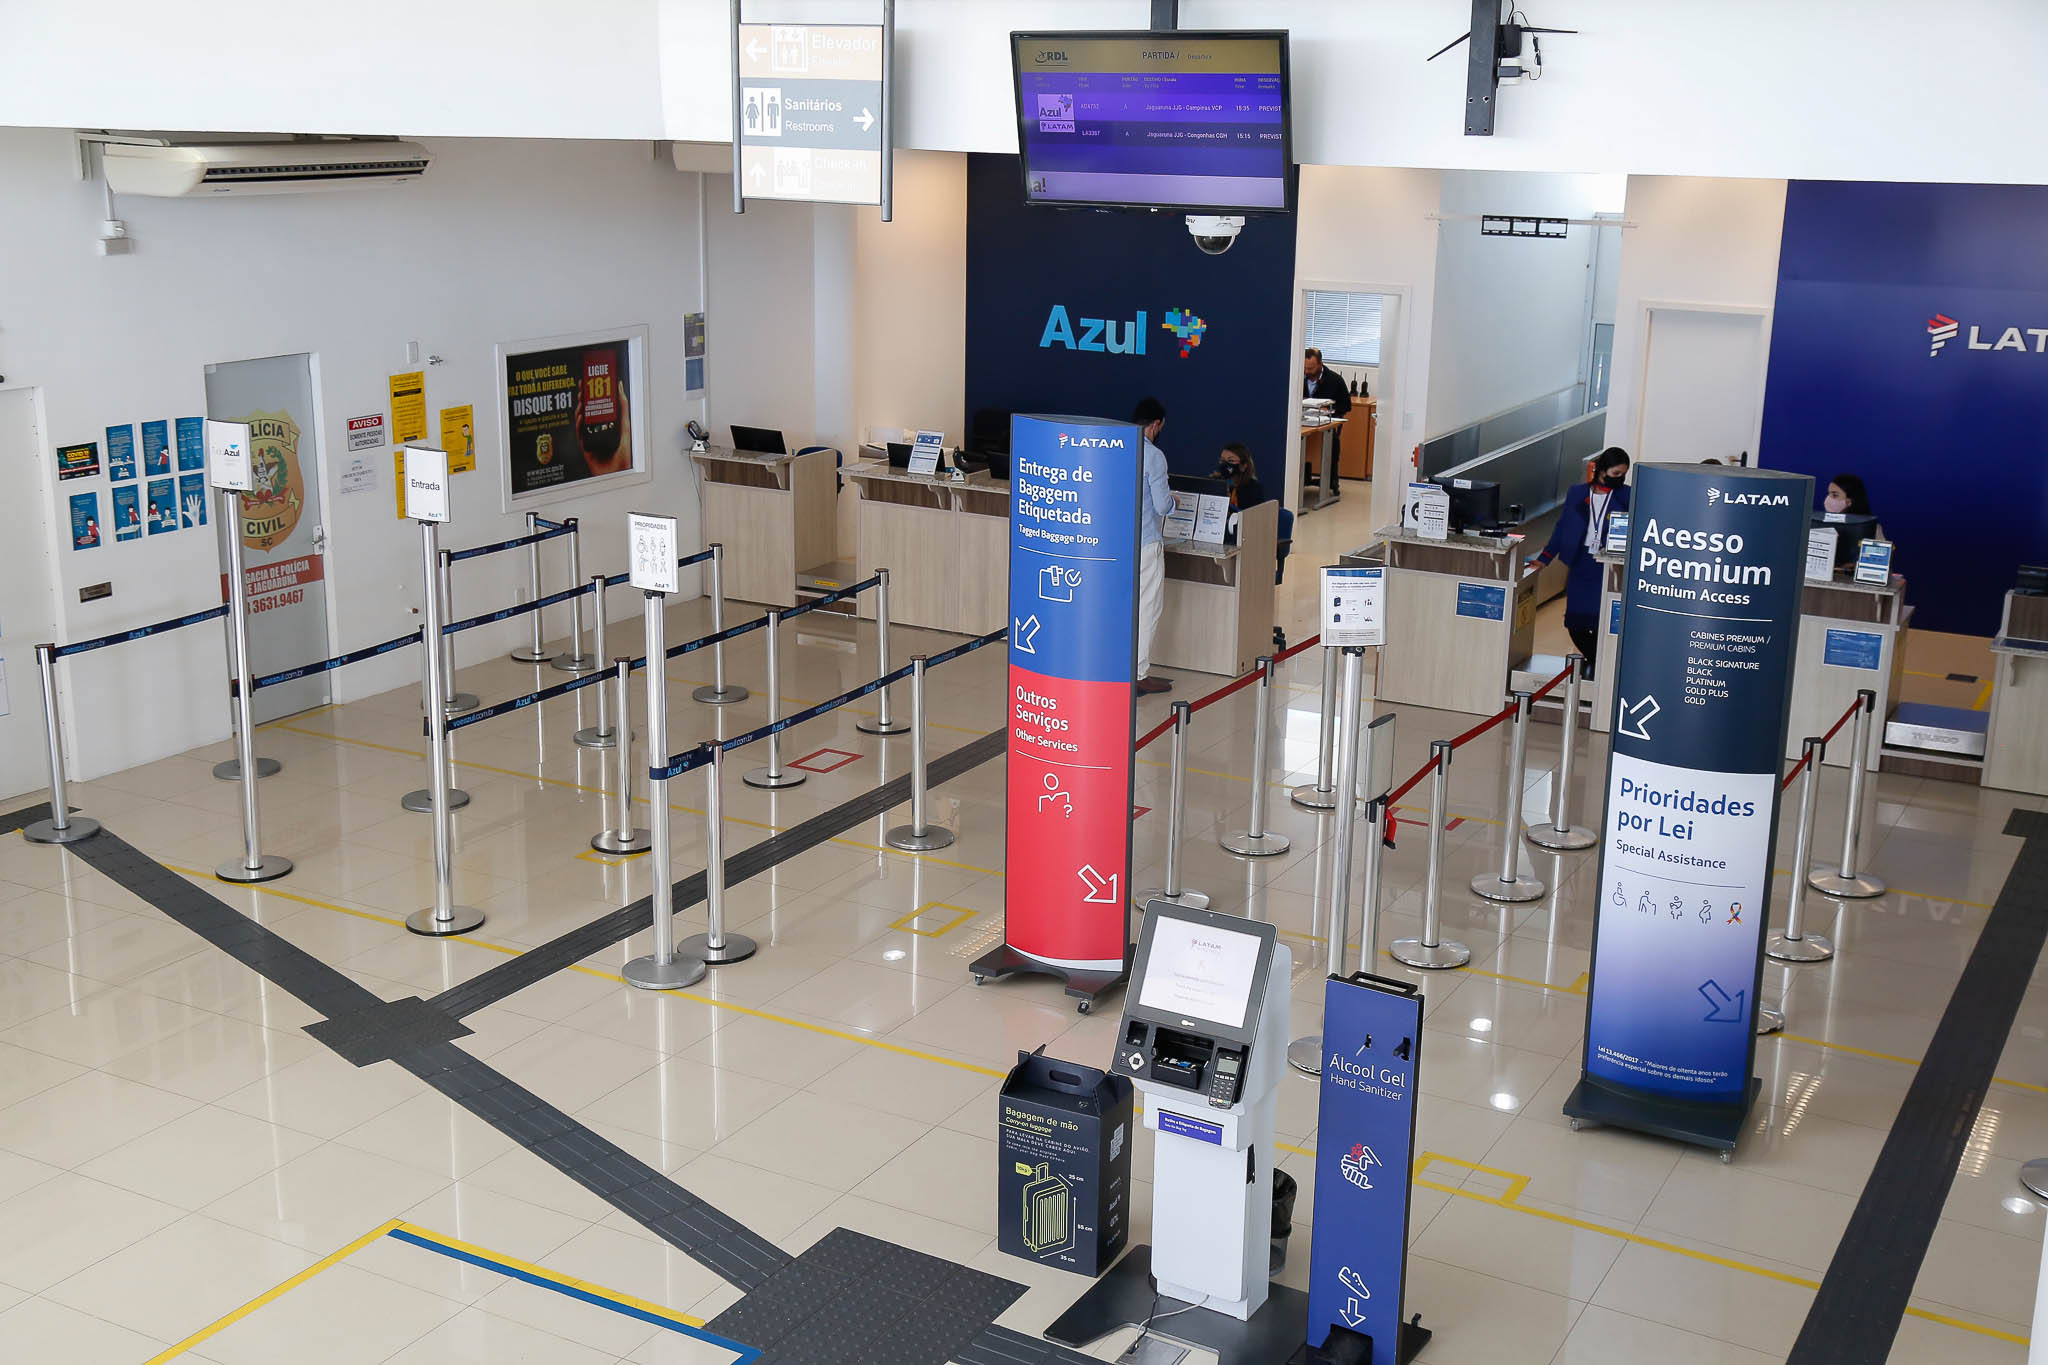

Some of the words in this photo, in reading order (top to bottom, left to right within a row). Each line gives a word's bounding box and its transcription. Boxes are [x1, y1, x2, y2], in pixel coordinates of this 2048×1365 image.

[811, 31, 877, 50] Elevador
[1046, 51, 1068, 61] RDL
[1142, 51, 1174, 60] PARTIDA
[784, 97, 843, 113] Sanitários
[1039, 107, 1062, 118] Azul
[785, 120, 834, 133] Restrooms
[1039, 304, 1147, 355] Azul
[1967, 325, 2048, 353] LAT
[521, 369, 534, 381] QUE
[551, 364, 568, 376] SABE
[588, 364, 609, 377] LIGUE
[520, 383, 536, 395] TODA
[587, 375, 611, 399] 181
[513, 394, 553, 416] DISQUE
[554, 391, 572, 410] 181
[250, 419, 285, 438] LÍCIA
[352, 417, 379, 429] AVISO
[355, 438, 380, 447] AUTORIZADAS
[1070, 437, 1124, 449] LATAM
[1019, 457, 1067, 484] Entrega
[1072, 465, 1093, 483] de
[411, 478, 441, 491] Entrada
[1018, 478, 1078, 504] Bagagem
[1724, 492, 1790, 506] LATAM
[1018, 499, 1092, 525] Etiquetada
[246, 517, 286, 535] CIVIL
[634, 521, 668, 530] PRIORIDADES
[260, 537, 273, 546] SC
[1018, 524, 1040, 538] Tagged
[1041, 529, 1075, 544] Baggage
[1076, 534, 1099, 546] Drop
[1642, 518, 1744, 554] Acesso
[269, 566, 280, 578] DE
[280, 560, 310, 576] POLÍCIA
[1639, 547, 1772, 586] Premium
[254, 574, 297, 594] JAGUARUNA
[1637, 578, 1696, 600] Premium
[1700, 588, 1750, 605] Access
[253, 588, 304, 614] 3631.9467
[128, 628, 145, 640] Azul
[1690, 630, 1725, 642] CABINES
[1726, 634, 1765, 644] PREMIUM
[685, 641, 699, 651] Azul
[1689, 641, 1726, 652] PREMIUM
[1727, 644, 1756, 653] CABINS
[325, 657, 341, 669] Azul
[1688, 656, 1714, 667] BLACK
[1715, 660, 1760, 671] SIGNATURE
[1687, 666, 1713, 677] BLACK
[1686, 676, 1726, 688] PLATINUM
[1016, 685, 1057, 710] Outros
[1685, 687, 1707, 696] GOLD
[1708, 688, 1729, 698] PLUS
[1684, 696, 1706, 706] GOLD
[453, 708, 494, 727] voeazul.com.br
[515, 695, 531, 707] Azul
[1015, 704, 1069, 733] Serviços
[771, 722, 786, 733] Azul
[1015, 728, 1036, 743] Other
[1037, 736, 1078, 753] Services
[1912, 731, 1959, 746] TOLEDO
[667, 762, 684, 777] Azul
[1620, 777, 1755, 817] Prioridades
[1617, 809, 1653, 832] por
[1659, 815, 1694, 841] Lei
[1616, 839, 1655, 859] Special
[1657, 850, 1727, 869] Assistance
[1198, 941, 1222, 950] LATAM
[1597, 1053, 1624, 1067] preferência
[1624, 1062, 1647, 1073] especial
[1647, 1068, 1664, 1077] sobre
[1672, 1073, 1694, 1082] demais
[1598, 1044, 1606, 1052] Lei
[1677, 1066, 1697, 1076] oitenta
[1712, 1070, 1728, 1078] terão
[1329, 1053, 1375, 1080] Álcool
[1380, 1068, 1405, 1088] Gel
[1330, 1072, 1356, 1089] Hand
[1359, 1081, 1402, 1101] Sanitizer
[1005, 1106, 1044, 1123] Bagagem
[1046, 1117, 1058, 1127] de
[1060, 1121, 1079, 1131] mão
[1005, 1117, 1029, 1127] Carry-on
[1029, 1124, 1052, 1133] luggage
[1019, 1132, 1035, 1140] LEVAR
[1044, 1138, 1062, 1147] CABINE
[1045, 1143, 1062, 1152] CABER
